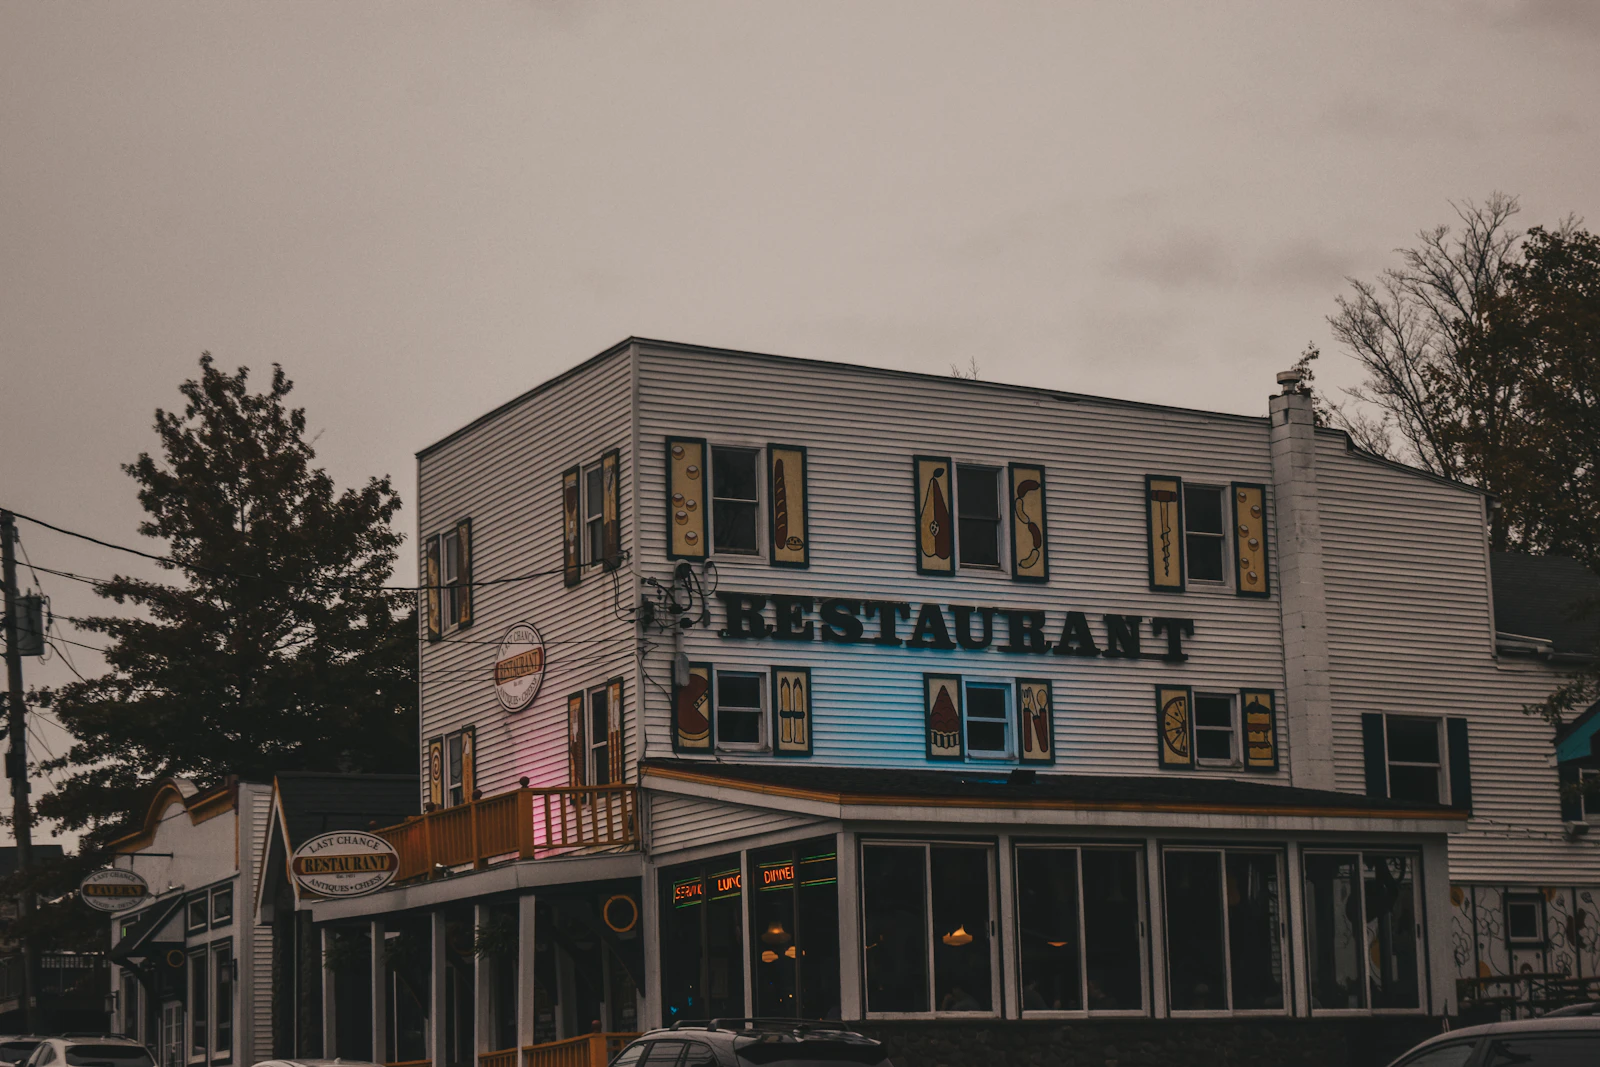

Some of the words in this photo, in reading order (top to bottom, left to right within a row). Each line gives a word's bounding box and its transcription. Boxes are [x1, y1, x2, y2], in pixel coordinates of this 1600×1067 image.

[716, 591, 1195, 662] RESTAURANT
[499, 651, 538, 681] RESTAURANT
[308, 837, 334, 853] LAST
[336, 836, 381, 850] CHANCE
[305, 855, 386, 872] RESTAURANT
[92, 872, 109, 882] LAST
[309, 878, 350, 892] ANTIQUES
[354, 874, 383, 891] CHEESE
[717, 874, 742, 892] LUNC
